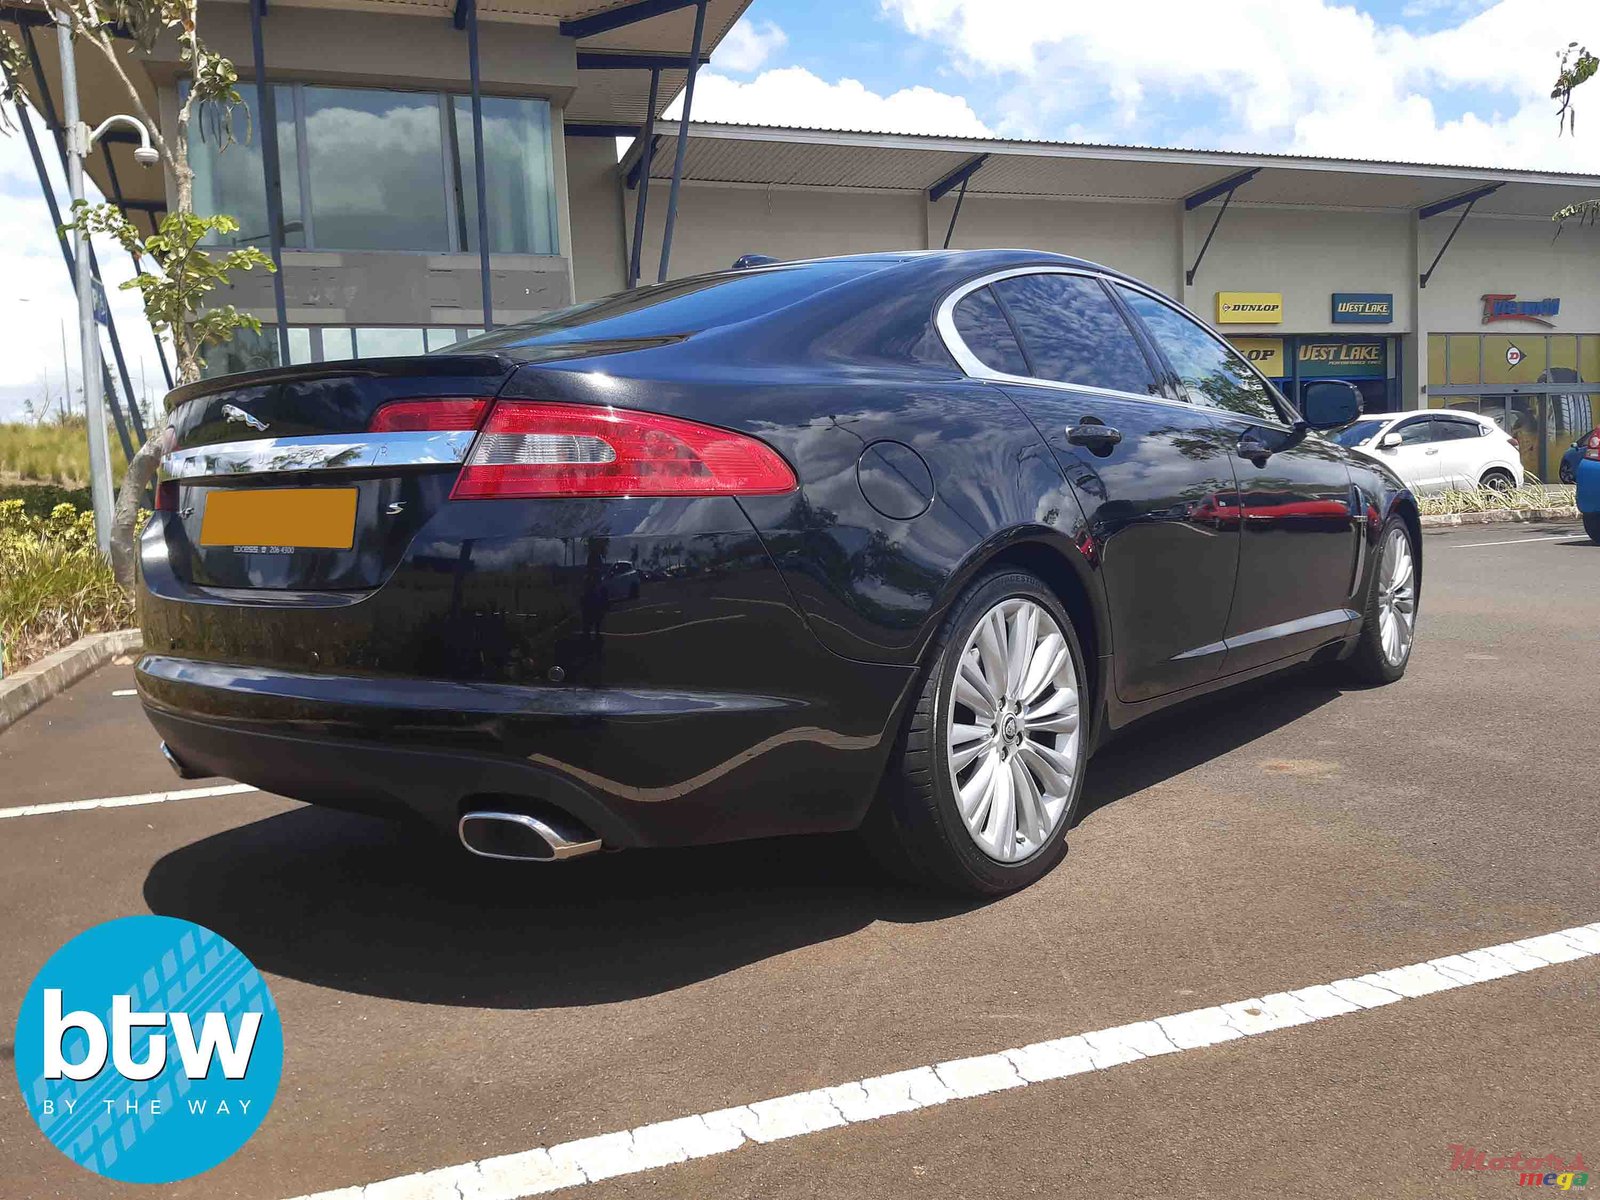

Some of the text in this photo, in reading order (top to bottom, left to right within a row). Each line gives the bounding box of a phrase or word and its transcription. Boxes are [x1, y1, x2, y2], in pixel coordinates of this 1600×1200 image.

[1337, 302, 1388, 313] WEST LAKE
[1340, 344, 1380, 360] LAKE
